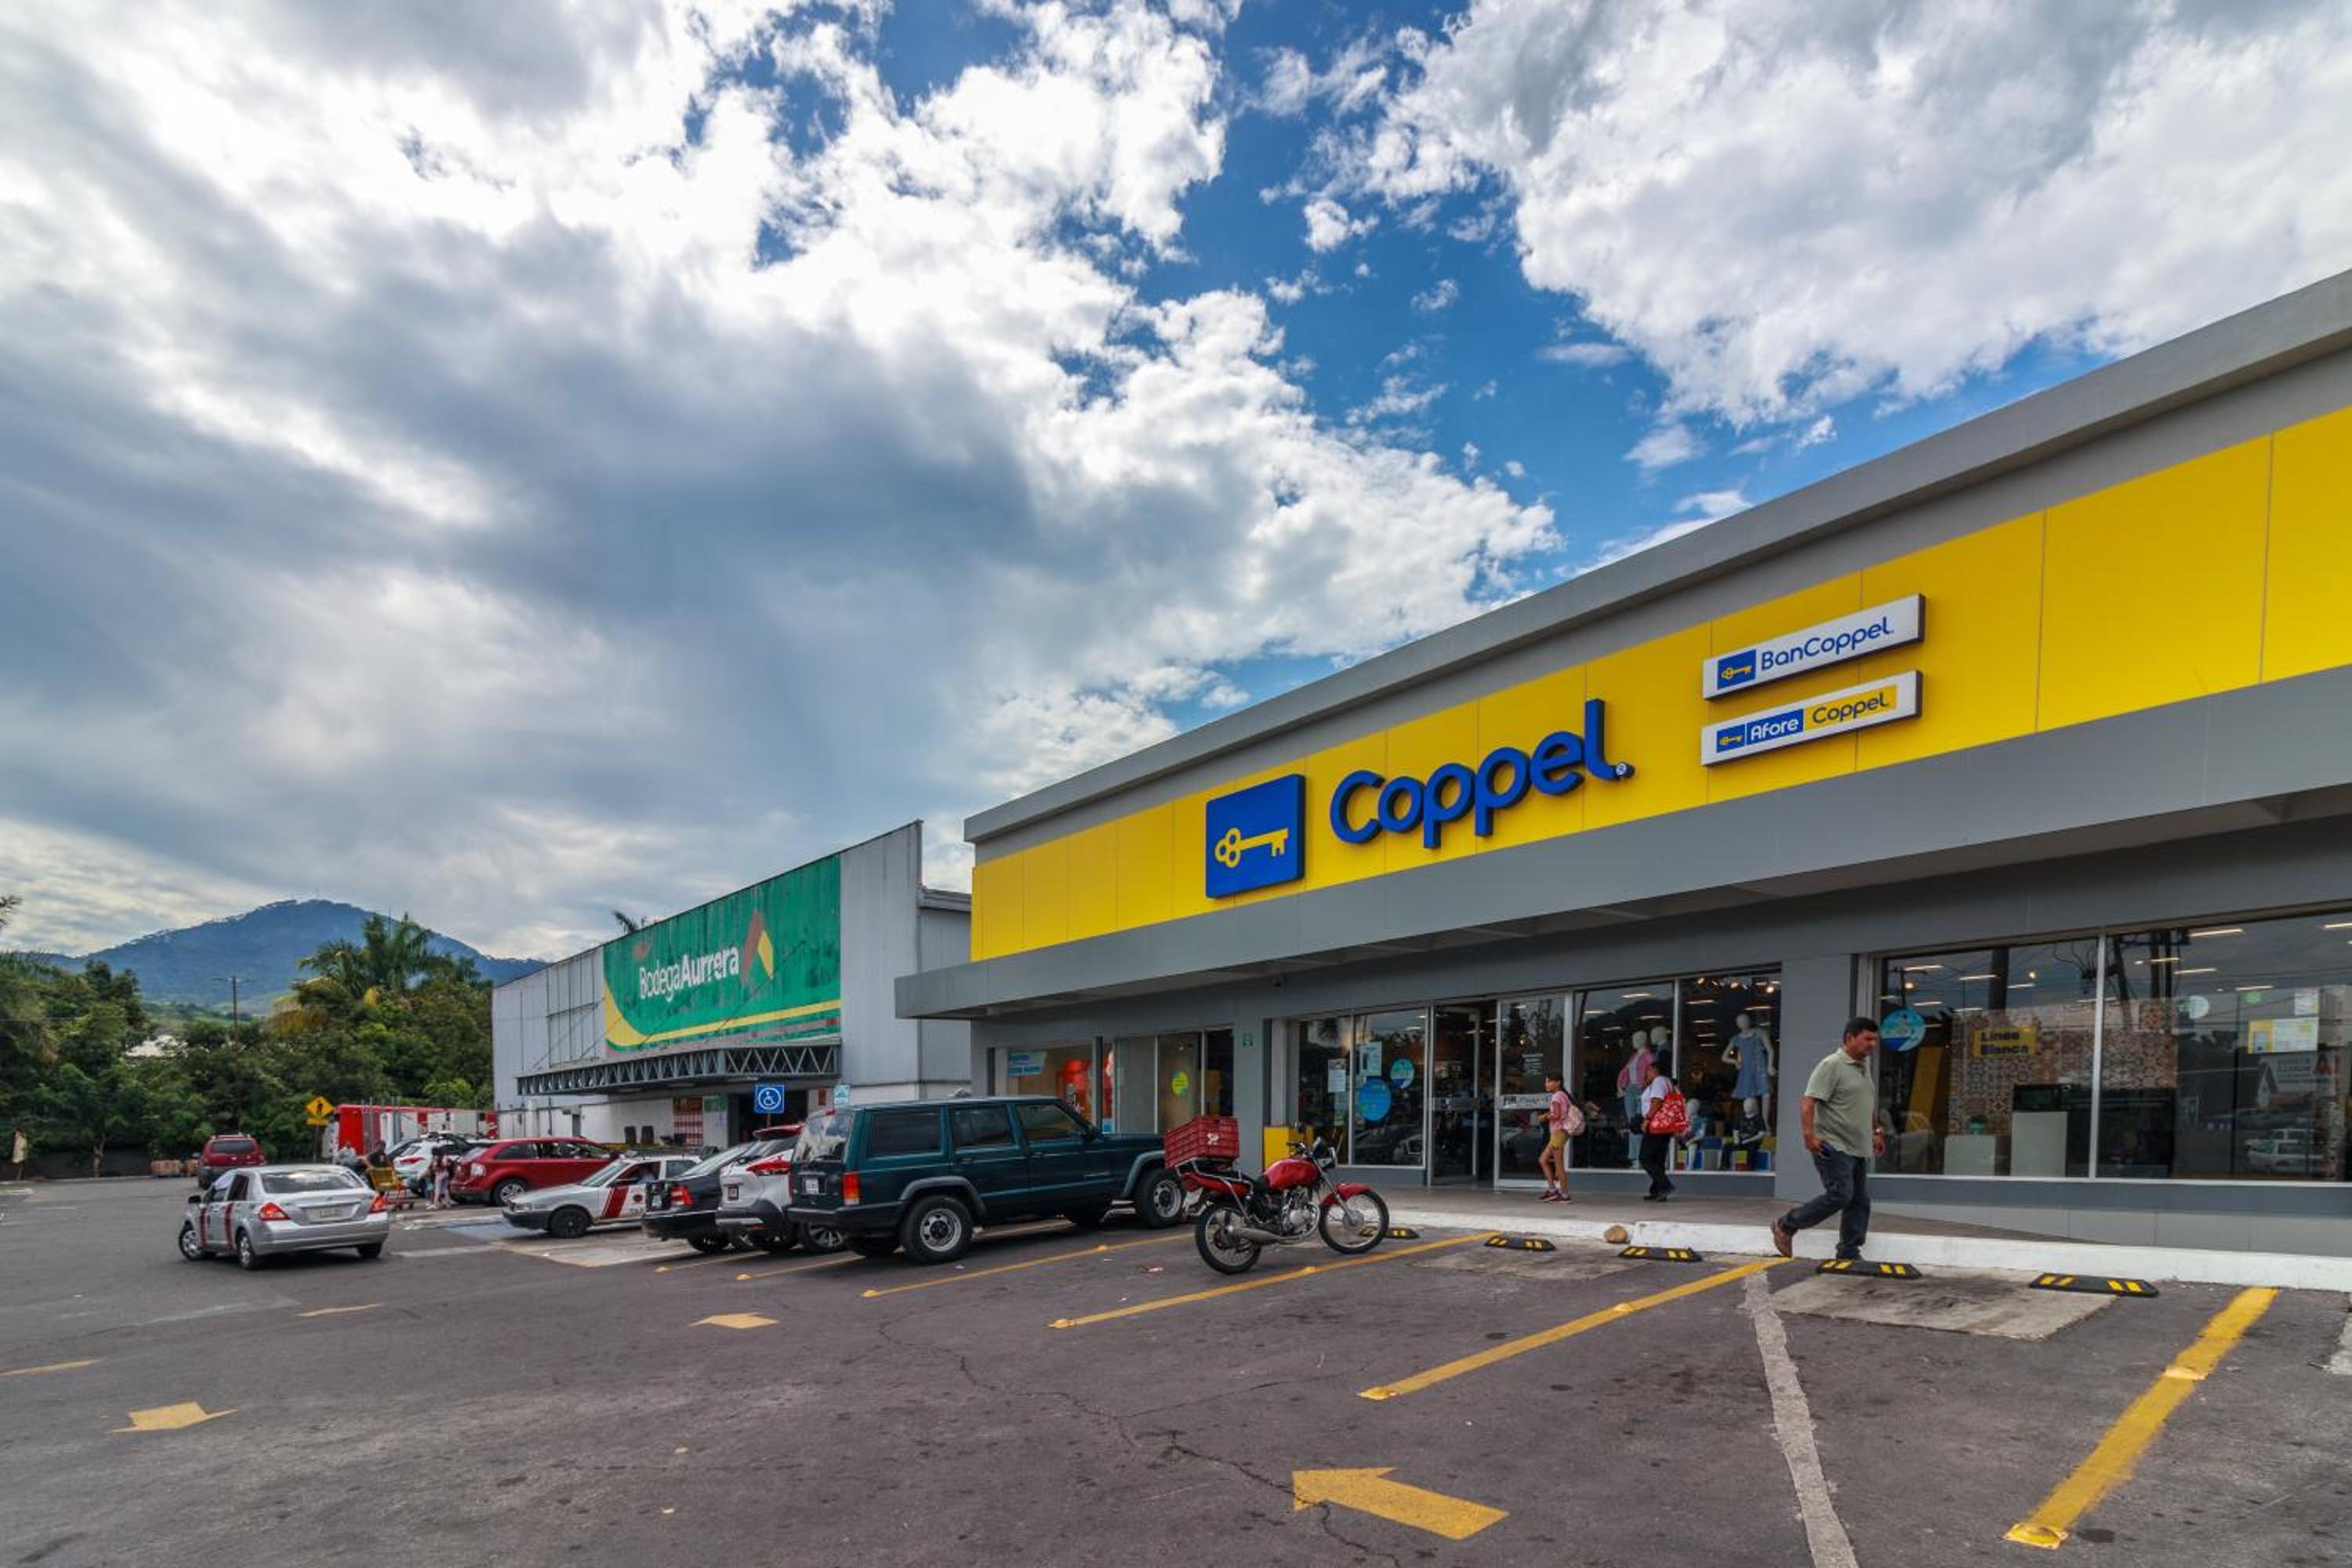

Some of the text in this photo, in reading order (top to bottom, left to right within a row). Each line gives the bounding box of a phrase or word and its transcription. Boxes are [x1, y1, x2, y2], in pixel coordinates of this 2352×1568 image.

[1761, 616, 1891, 671] BanCoppel
[1751, 692, 1886, 741] Afore Coppel
[1330, 699, 1618, 848] Coppel
